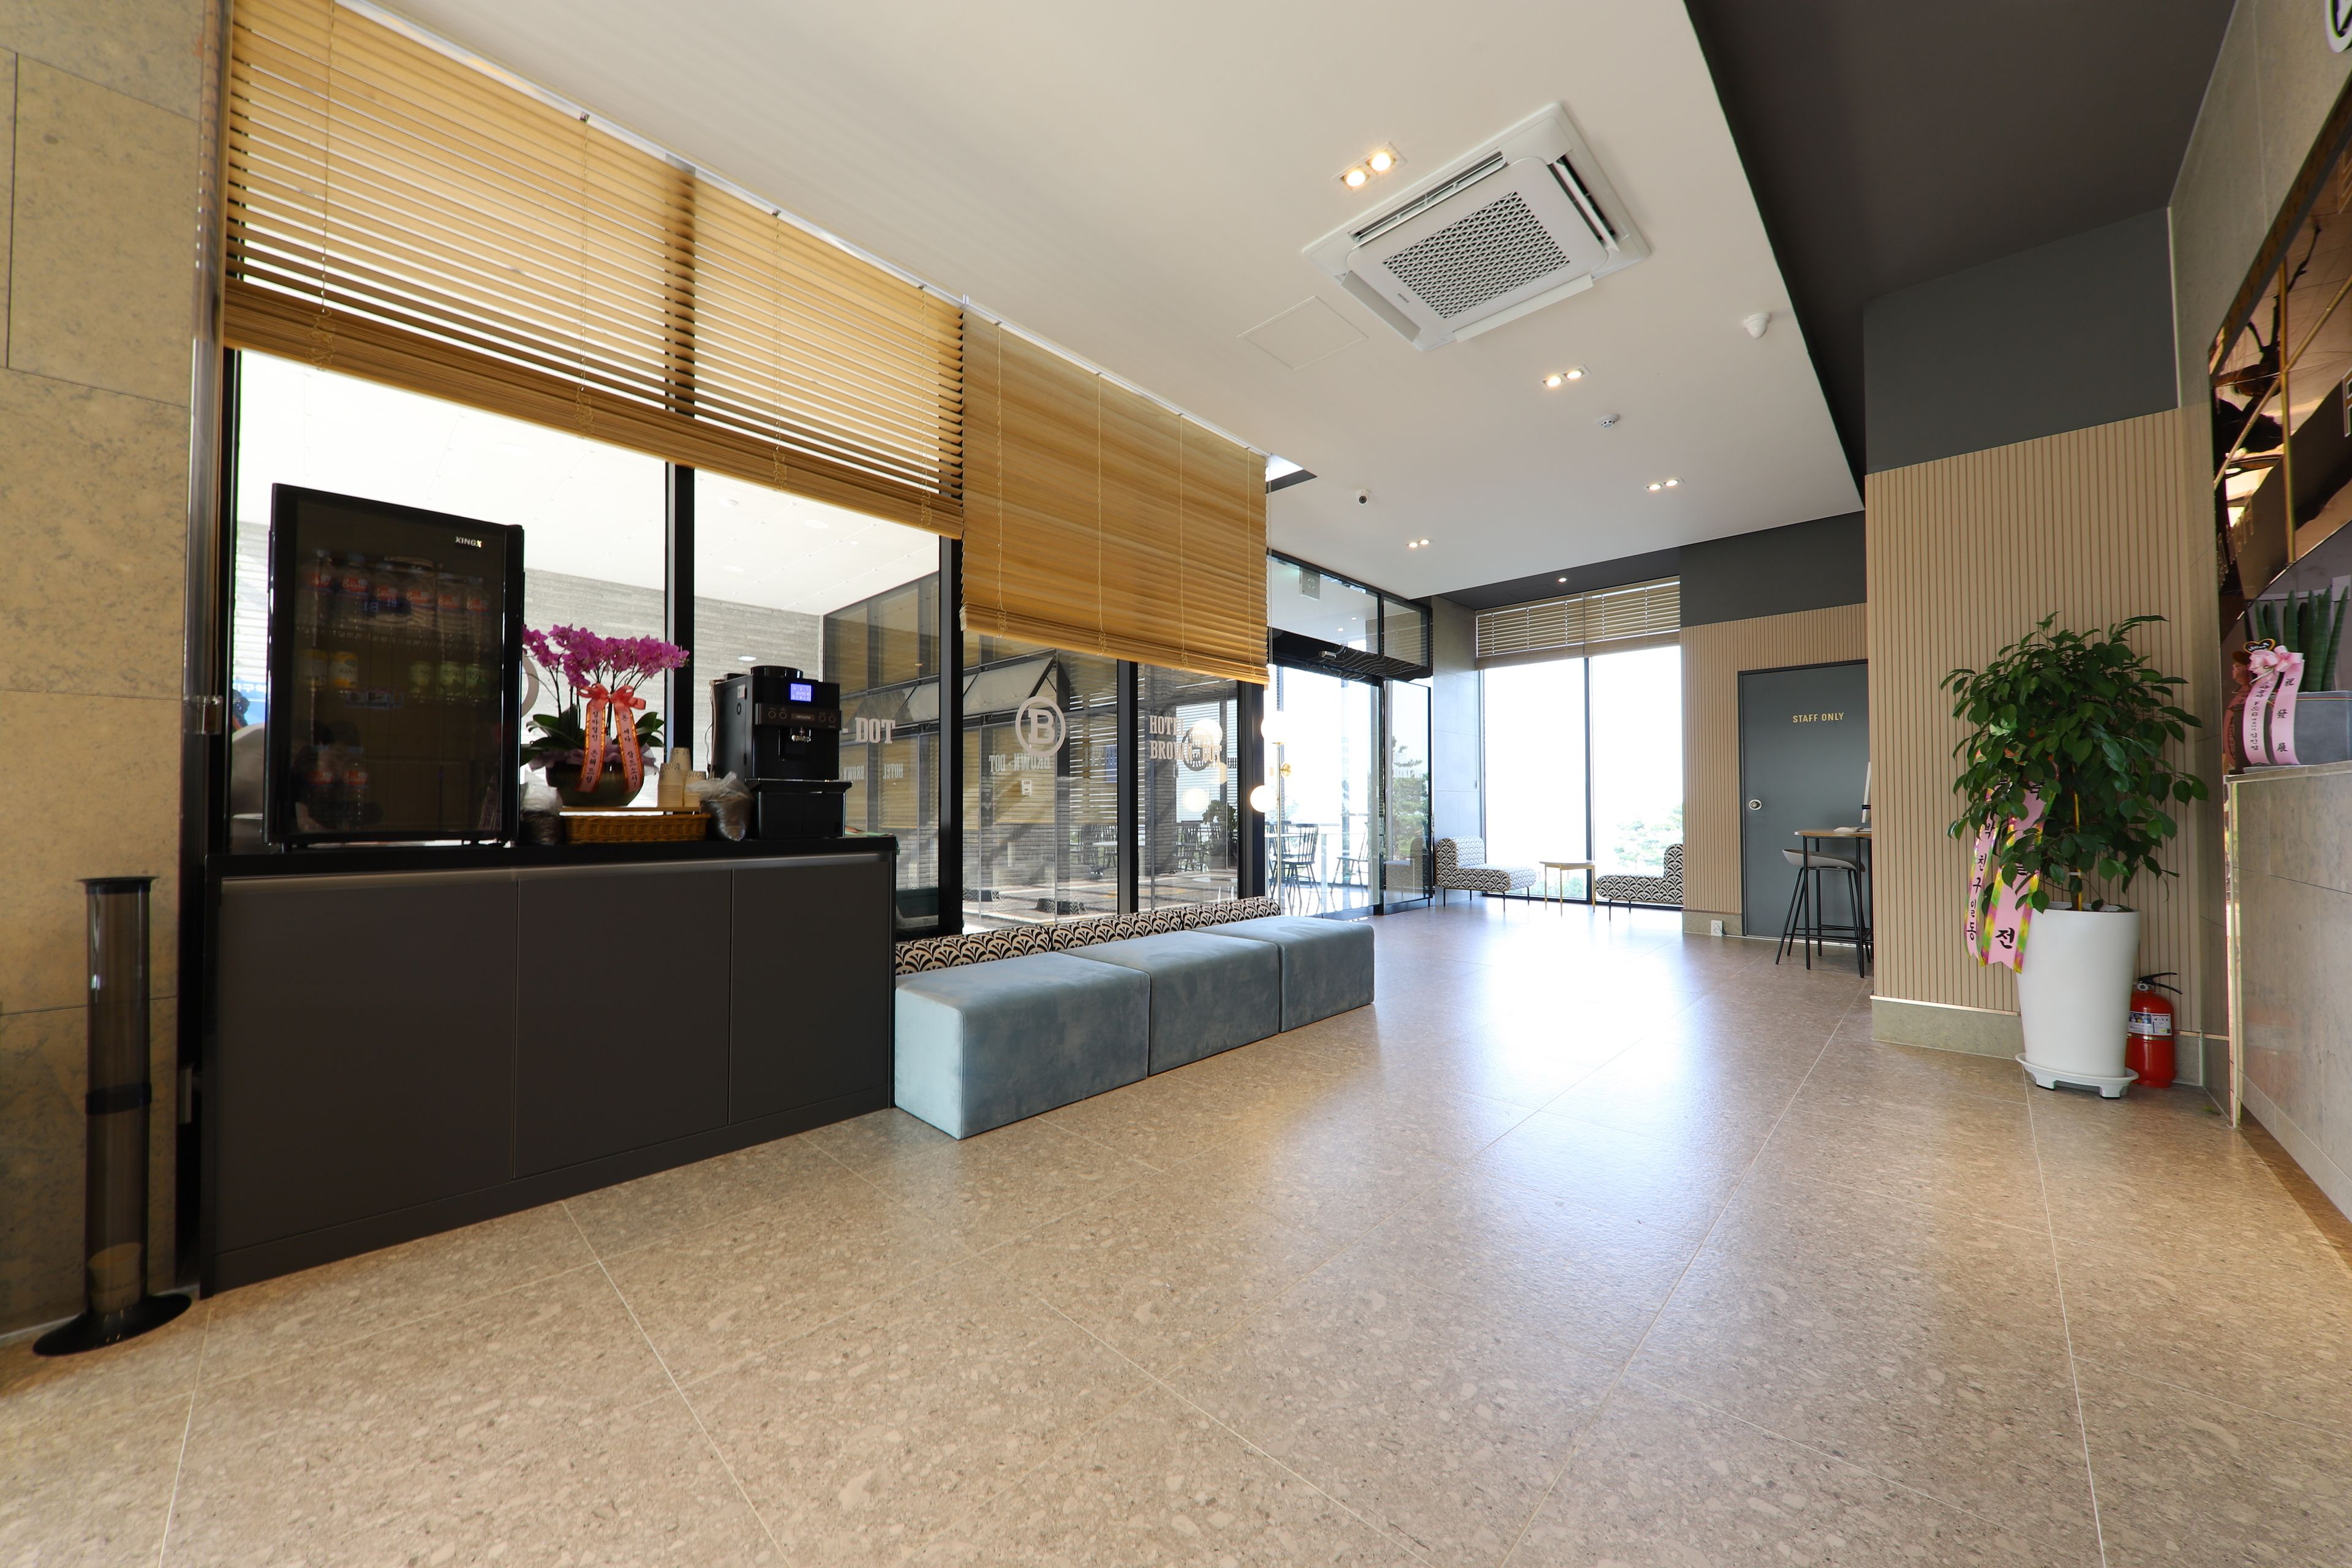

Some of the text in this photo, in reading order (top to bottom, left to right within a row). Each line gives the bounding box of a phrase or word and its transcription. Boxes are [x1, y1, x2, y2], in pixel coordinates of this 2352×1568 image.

[1150, 715, 1185, 736] HOTEL
[1793, 712, 1844, 723] STAFF ONLY
[855, 717, 896, 744] DOT
